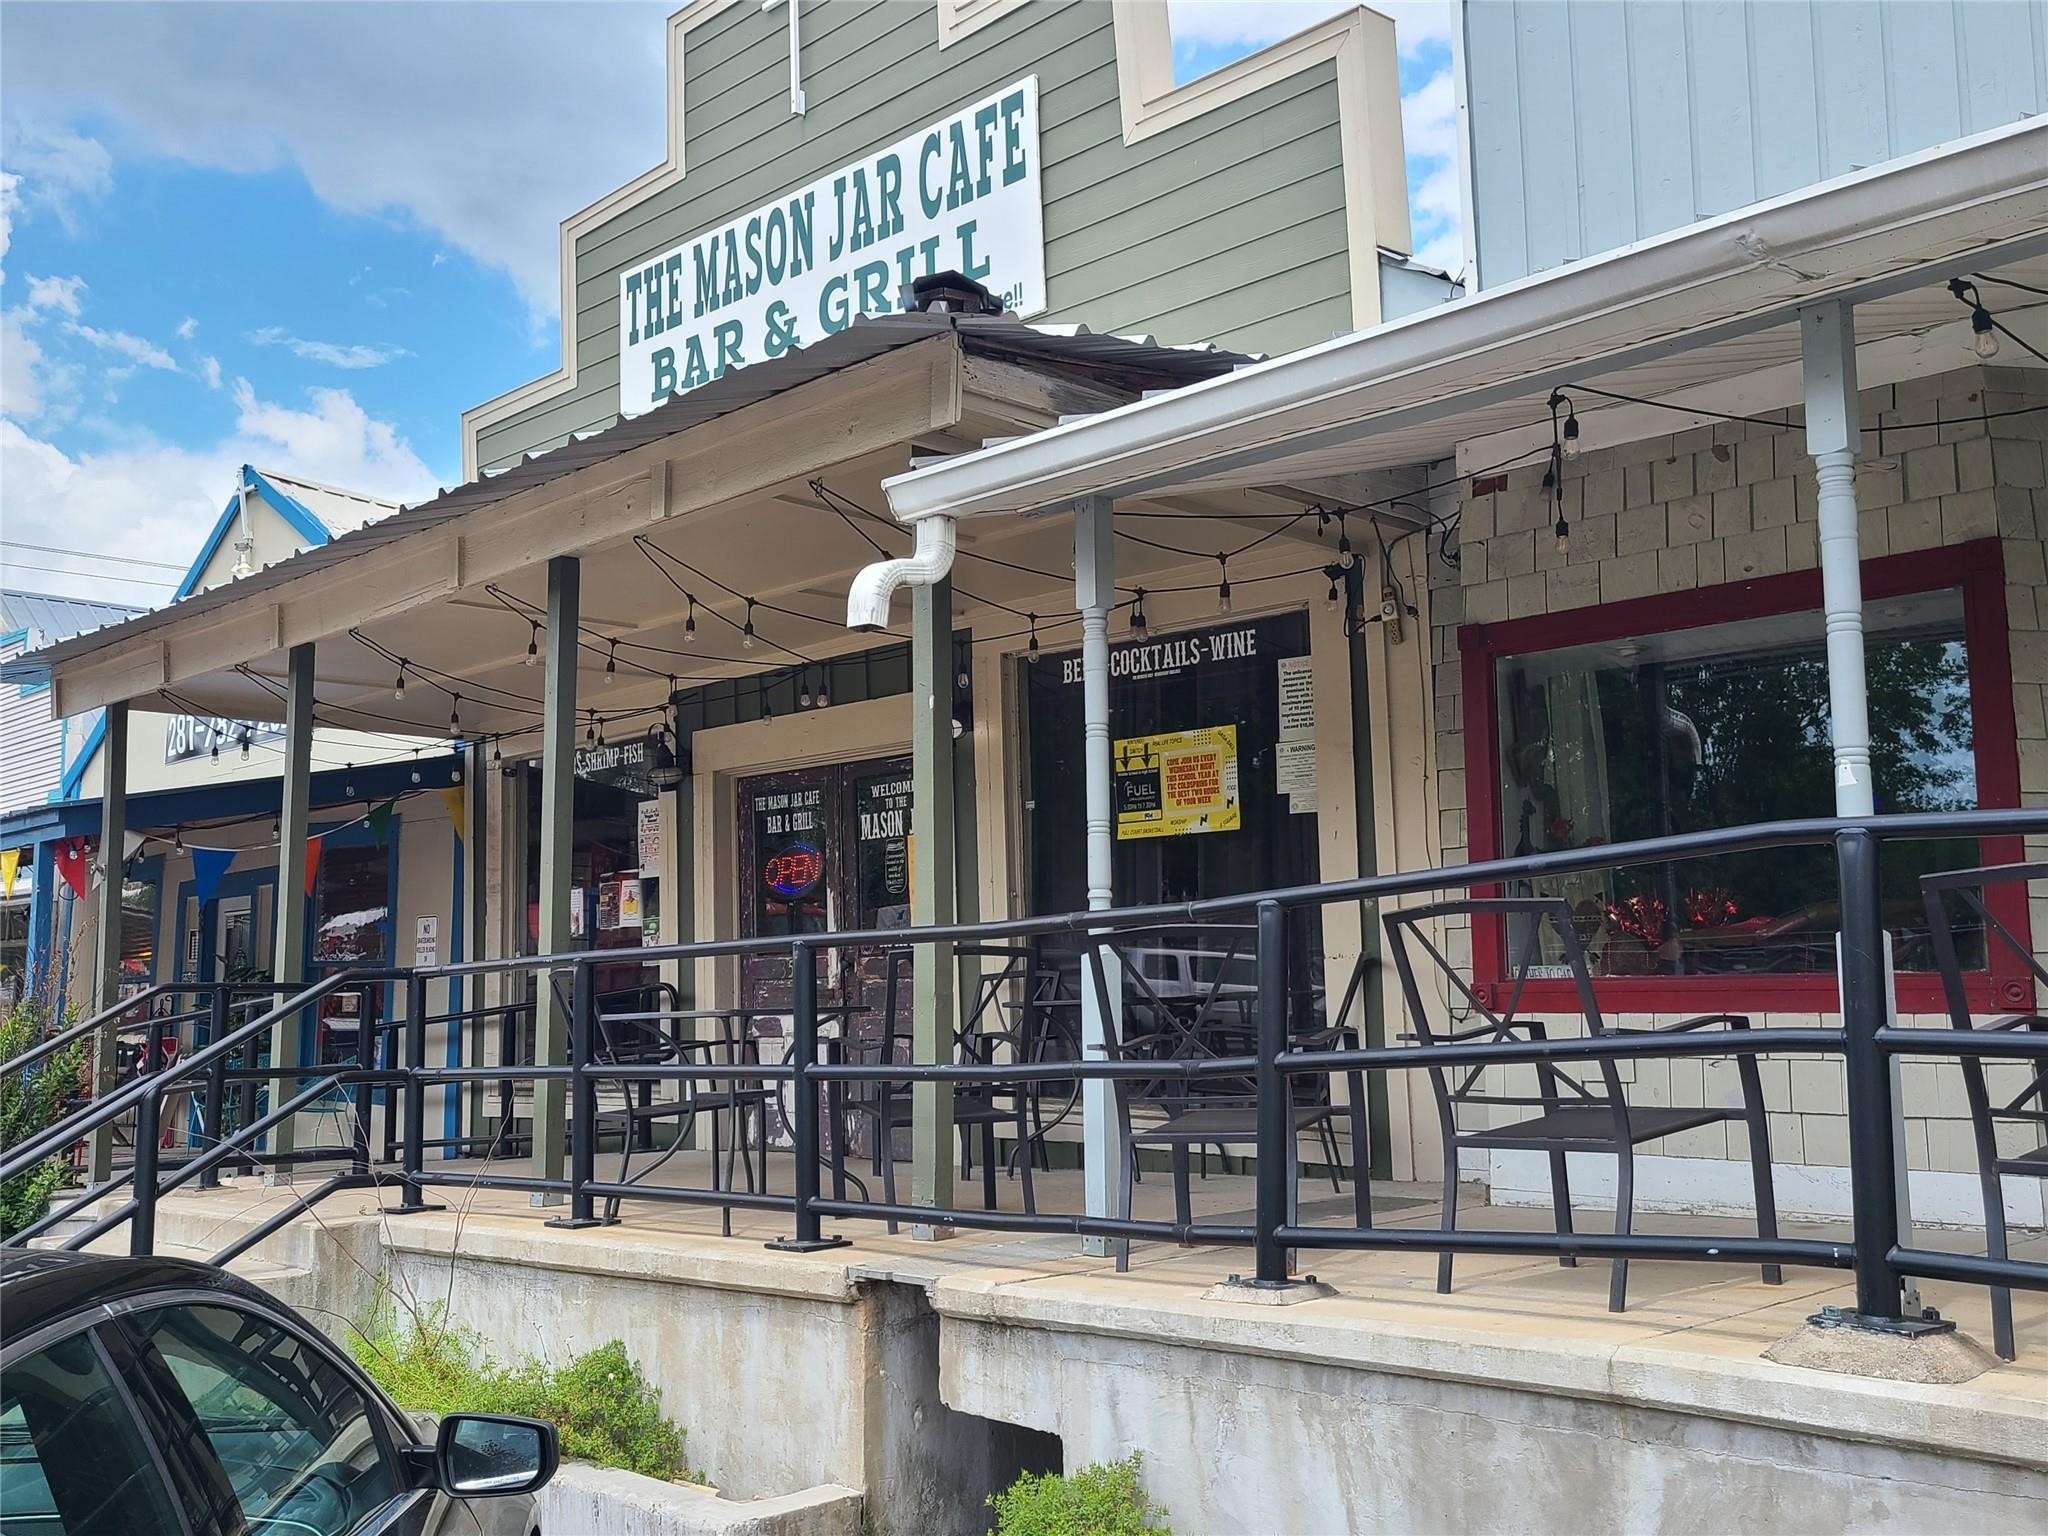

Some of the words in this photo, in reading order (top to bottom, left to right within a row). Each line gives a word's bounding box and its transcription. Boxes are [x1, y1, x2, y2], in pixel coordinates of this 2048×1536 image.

[625, 252, 682, 346] THE
[692, 190, 815, 319] MASON
[829, 152, 904, 262] JAR
[918, 88, 1028, 221] CAFE
[651, 318, 745, 403] BAR
[764, 299, 800, 358] &
[1062, 629, 1257, 684] BECOCKTAILS-WINE
[1289, 744, 1316, 753] WARNING
[1167, 757, 1180, 766] COME
[1181, 755, 1192, 765] JOIN
[1200, 753, 1216, 762] EVERY
[1169, 764, 1199, 774] WEDNESDAY
[1200, 762, 1215, 771] NIGHT
[1166, 774, 1177, 783] THIS
[1178, 772, 1197, 781] SCHOOL
[1197, 771, 1211, 779] YEAR
[1212, 770, 1219, 778] AT
[871, 780, 914, 798] WELCOM
[1126, 783, 1155, 797] FUEL
[1167, 791, 1177, 799] THE
[1178, 789, 1190, 798] BEST
[1191, 788, 1203, 796] TWO
[755, 797, 766, 812] THE
[768, 794, 789, 811] MASON
[790, 792, 803, 807] JAR
[804, 790, 820, 806] CAFE
[884, 798, 893, 810] TO
[896, 796, 907, 808] THE
[1198, 796, 1211, 804] WEEK
[767, 813, 782, 834] BAR
[785, 814, 790, 832] &
[792, 811, 813, 831] GRILL
[860, 810, 904, 841] MASON
[765, 851, 821, 887] OPEN
[423, 923, 430, 934] NO
